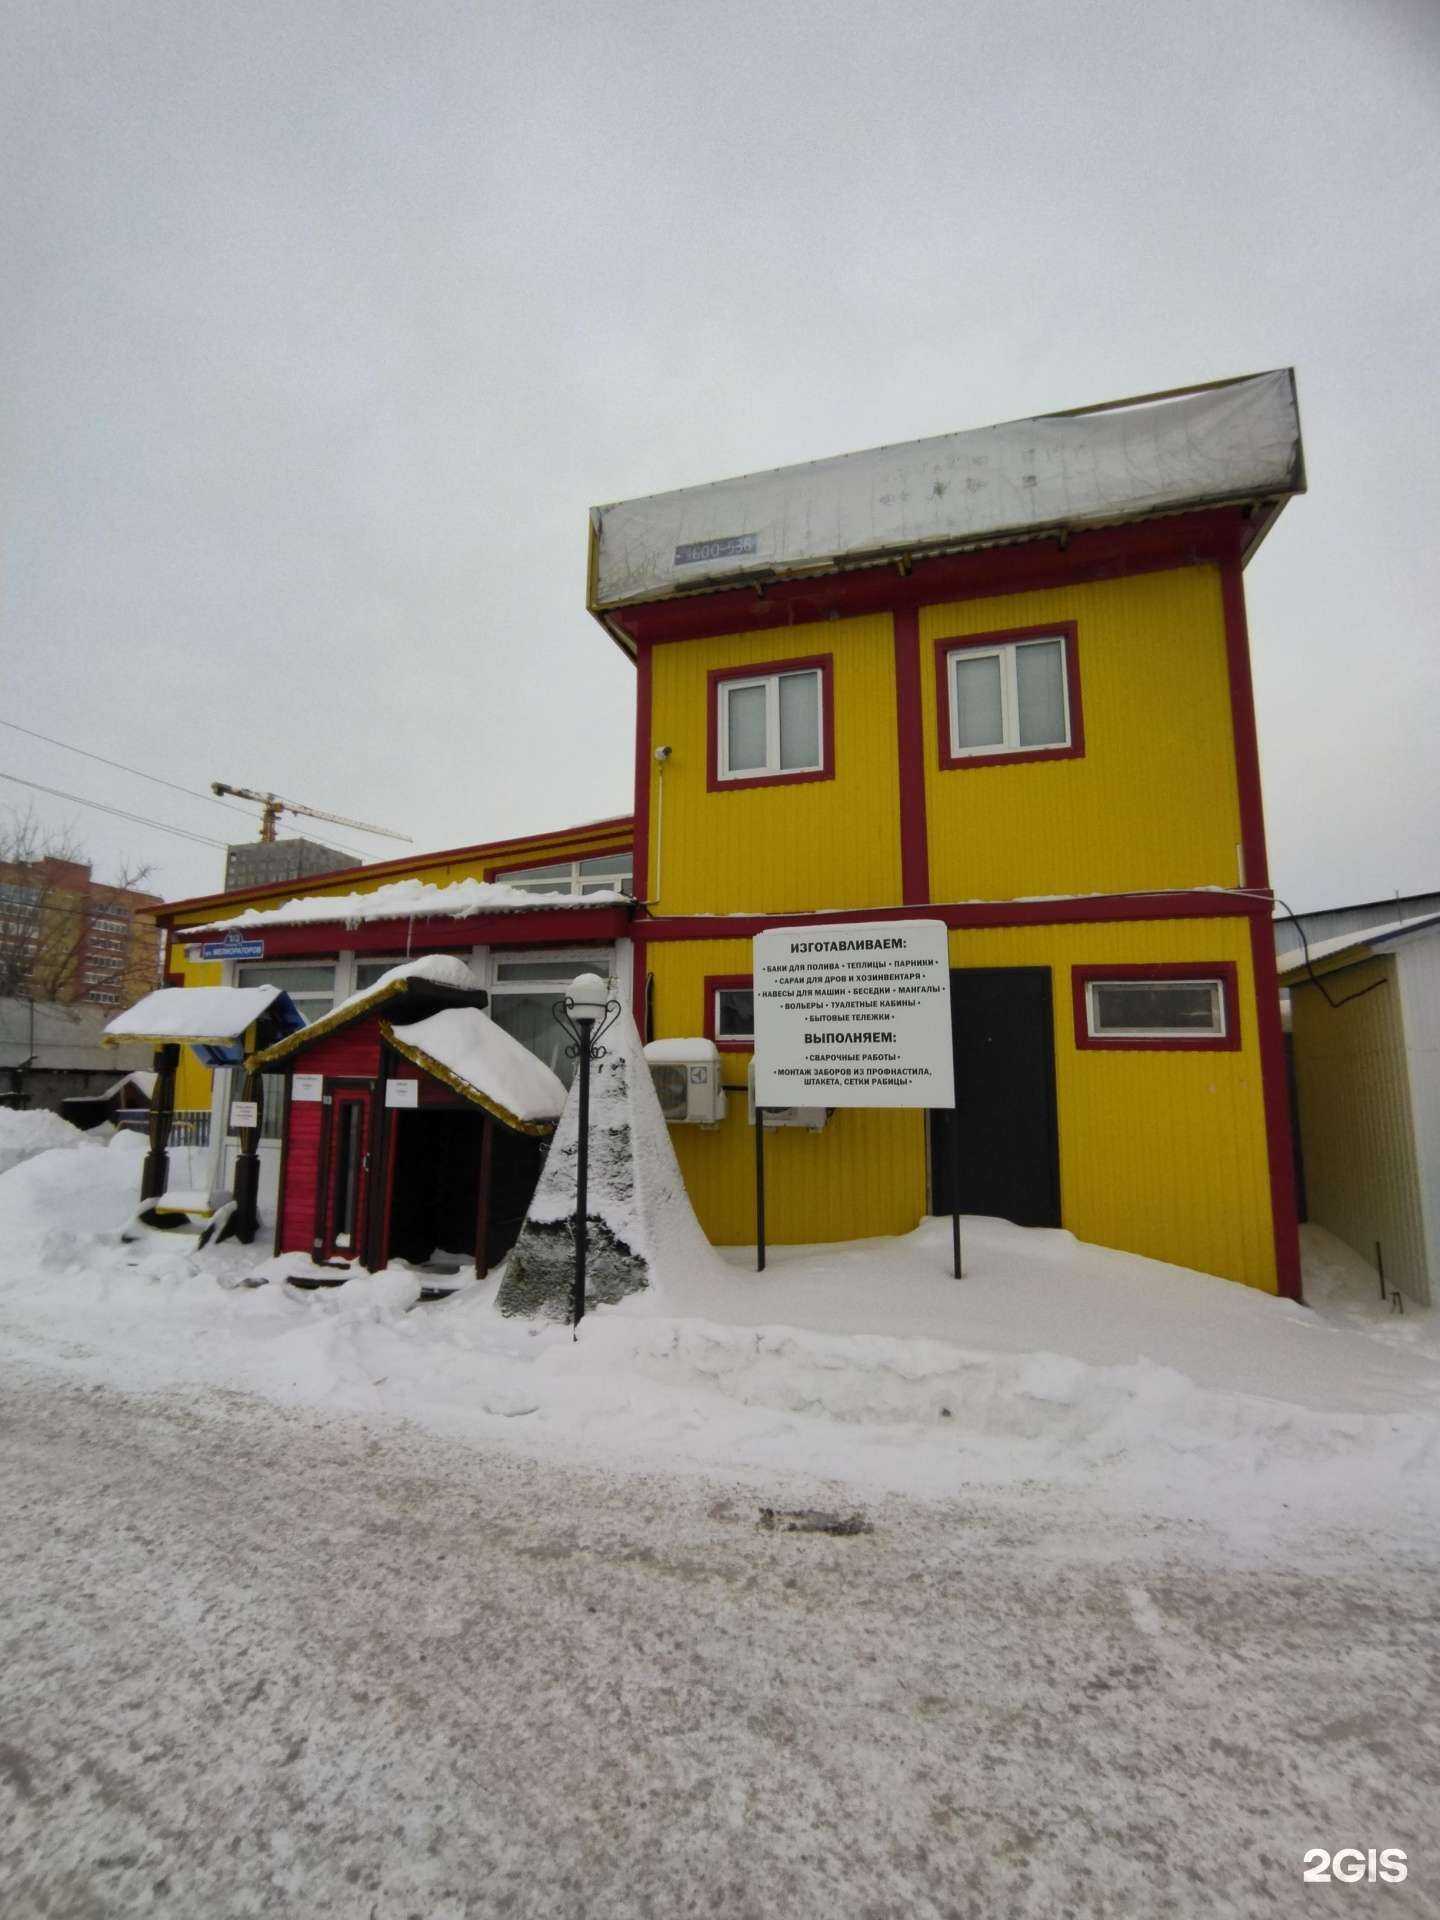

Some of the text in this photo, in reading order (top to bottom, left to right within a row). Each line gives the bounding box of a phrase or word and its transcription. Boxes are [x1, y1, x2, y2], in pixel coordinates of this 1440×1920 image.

[791, 939, 907, 953] ИЗГОТАВЛИВАЕМ:
[789, 964, 805, 972] ДЛЯ
[807, 963, 839, 971] ПОЛИВА
[847, 961, 886, 969] ТЕПЛИЦЫ
[894, 960, 934, 968] ПАРНИКИ
[806, 976, 823, 985] ДЛЯ
[856, 973, 920, 982] ХОЗИНВЕНТАРЯ
[763, 989, 795, 997] НАВЕСЫ
[796, 989, 813, 997] ДЛЯ
[815, 988, 845, 996] МАШИН
[898, 986, 940, 994] МАНГАЛЫ
[785, 1002, 823, 1010] ВОЛЬЕРЫ
[831, 1001, 878, 1009] ТУАЛЕТНЫЕ
[810, 1014, 850, 1022] БЫТОВЫЕ
[805, 1032, 896, 1044] ВЫПОЛНЯЕМ:
[778, 1068, 811, 1076] МОНТАЖ
[867, 1068, 932, 1076] ПРОФНАСТИЛА,
[804, 1078, 842, 1086] ШТАКЕТА,
